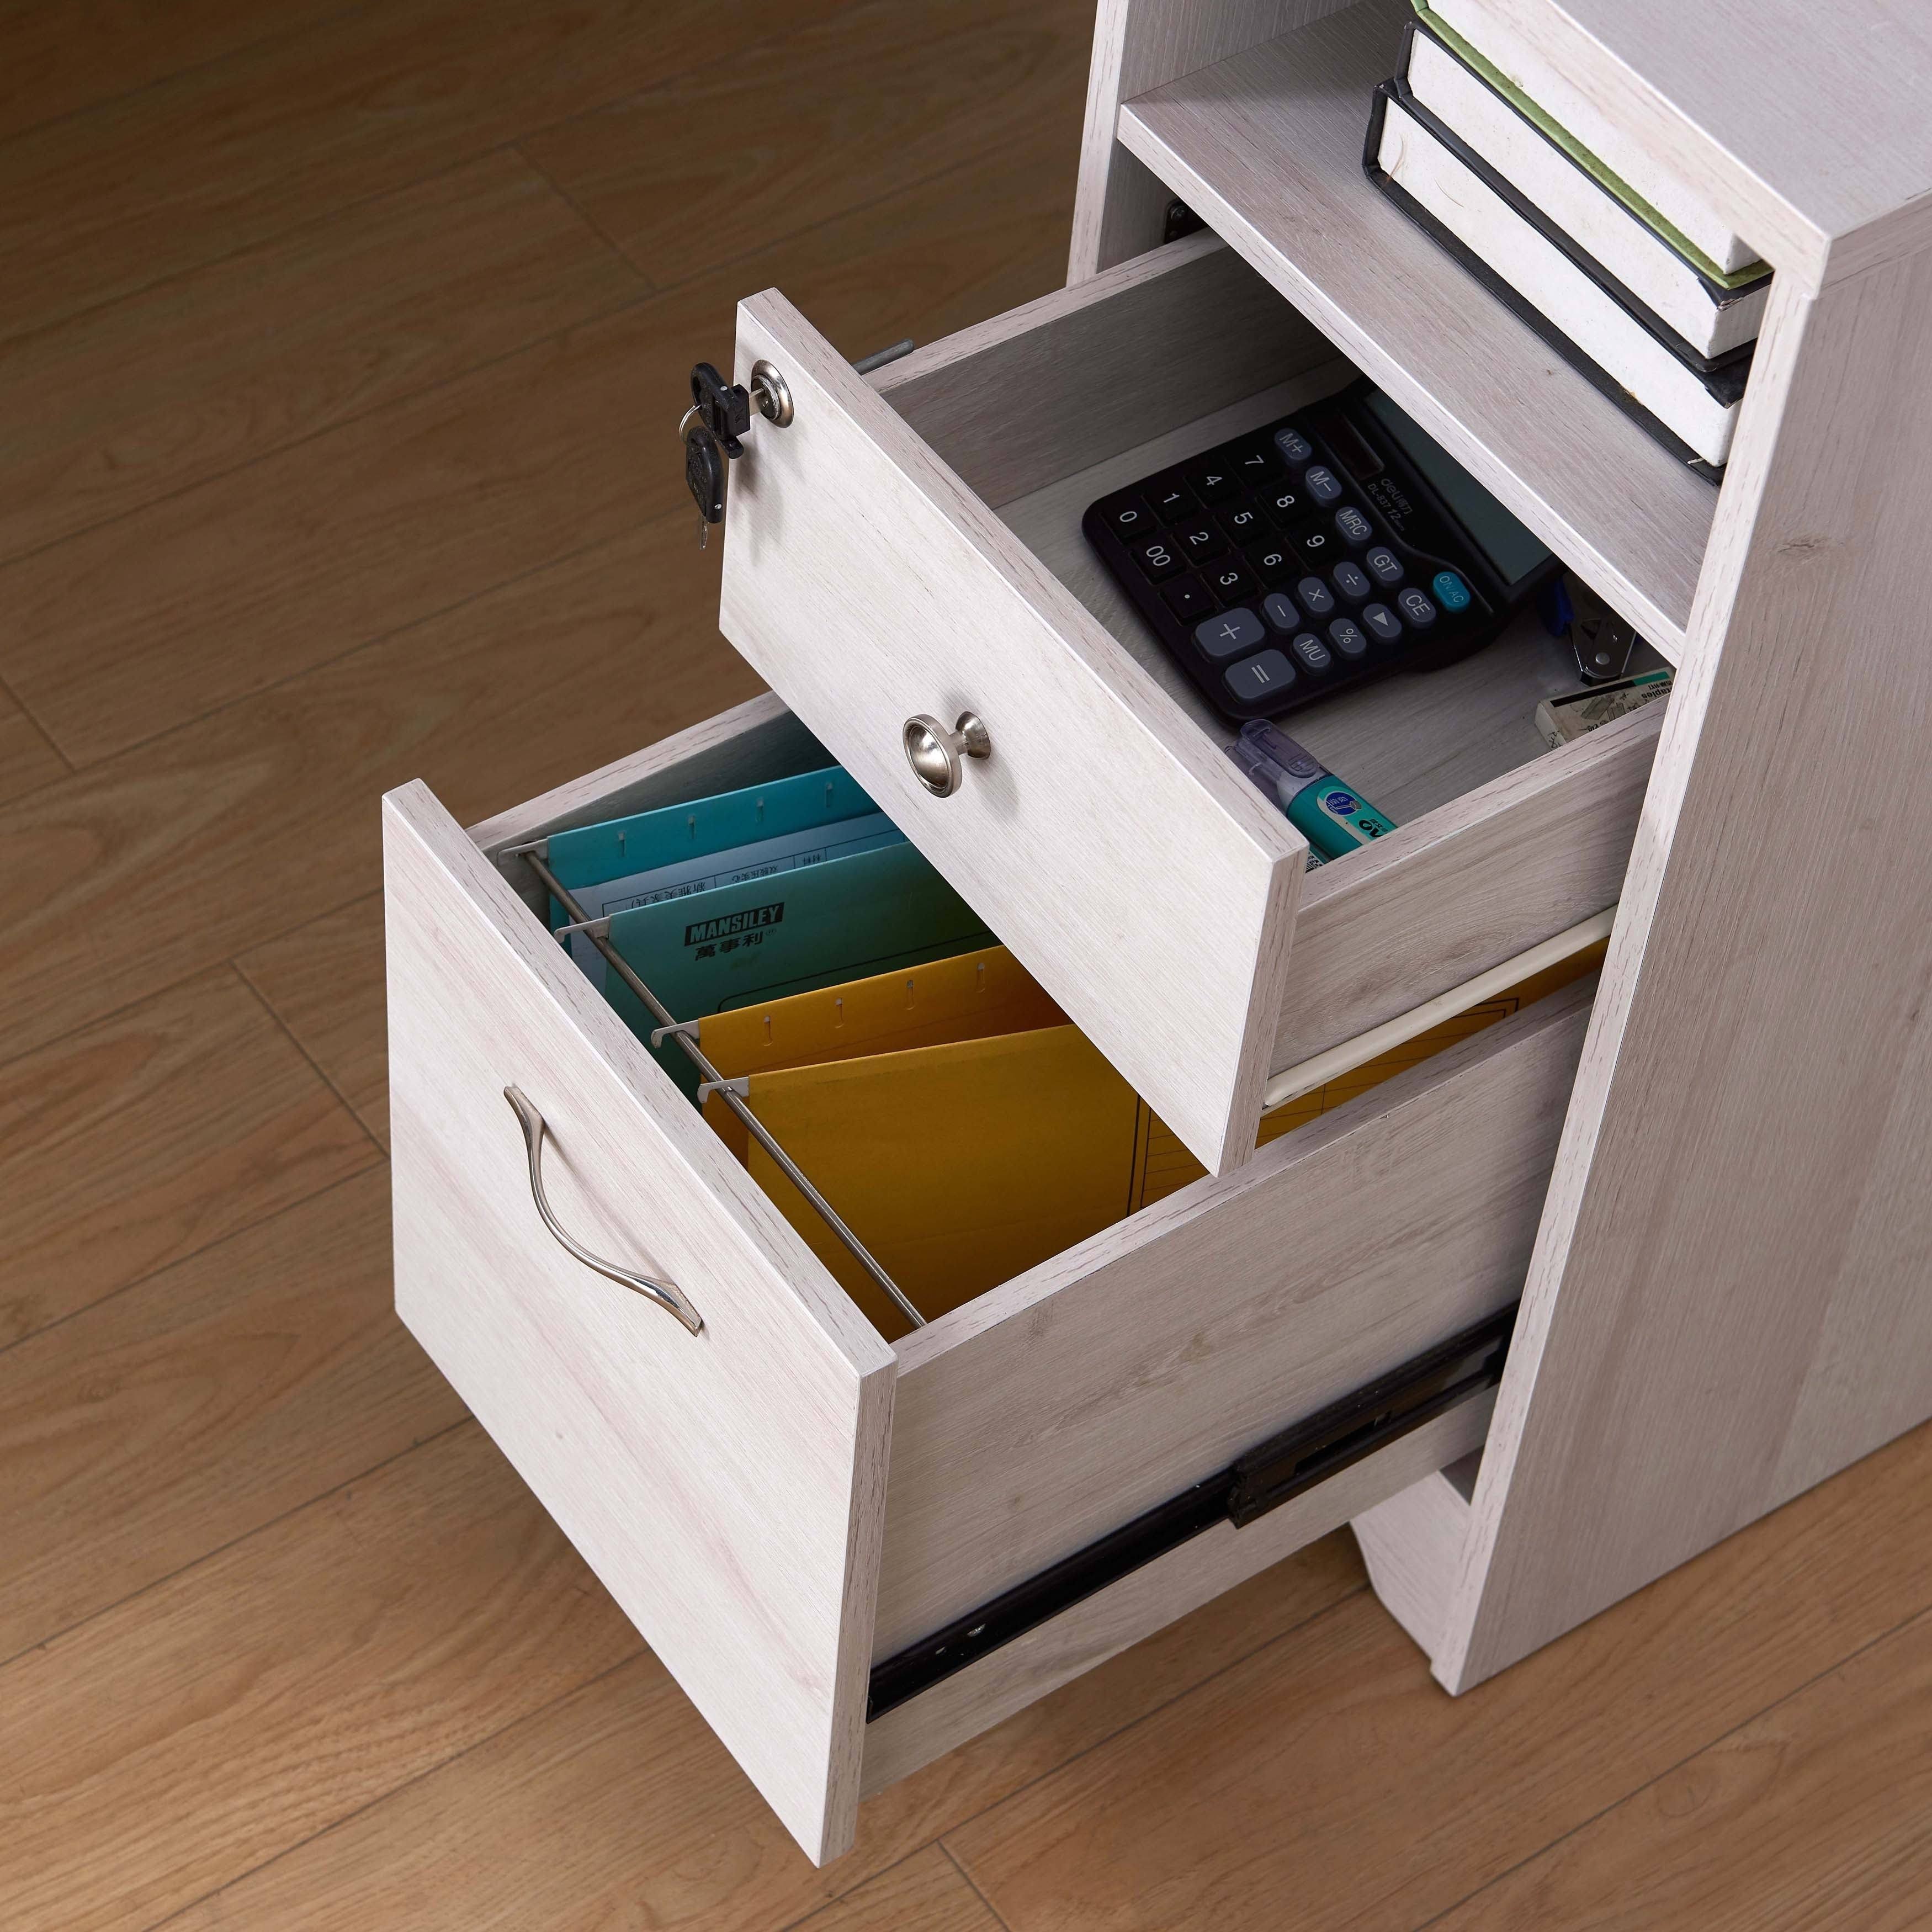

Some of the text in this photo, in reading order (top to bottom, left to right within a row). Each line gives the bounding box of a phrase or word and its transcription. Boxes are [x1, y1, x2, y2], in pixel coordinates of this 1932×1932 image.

[1279, 432, 1303, 453] M+
[1245, 454, 1265, 465] 7
[1206, 476, 1223, 486] 4
[1163, 493, 1180, 503] 1
[1276, 495, 1295, 508] 8
[1119, 511, 1138, 523] 0
[1234, 512, 1254, 524] 5
[1339, 509, 1368, 535] MRC
[1189, 532, 1209, 545] 2
[1306, 535, 1325, 548] 9
[1145, 545, 1171, 566] 00
[1263, 553, 1282, 566] 6
[1373, 554, 1398, 573] GT
[1219, 572, 1239, 585] 3
[1405, 595, 1431, 617] CE
[1299, 639, 1326, 661] MU
[689, 905, 781, 943] MANSILEY
